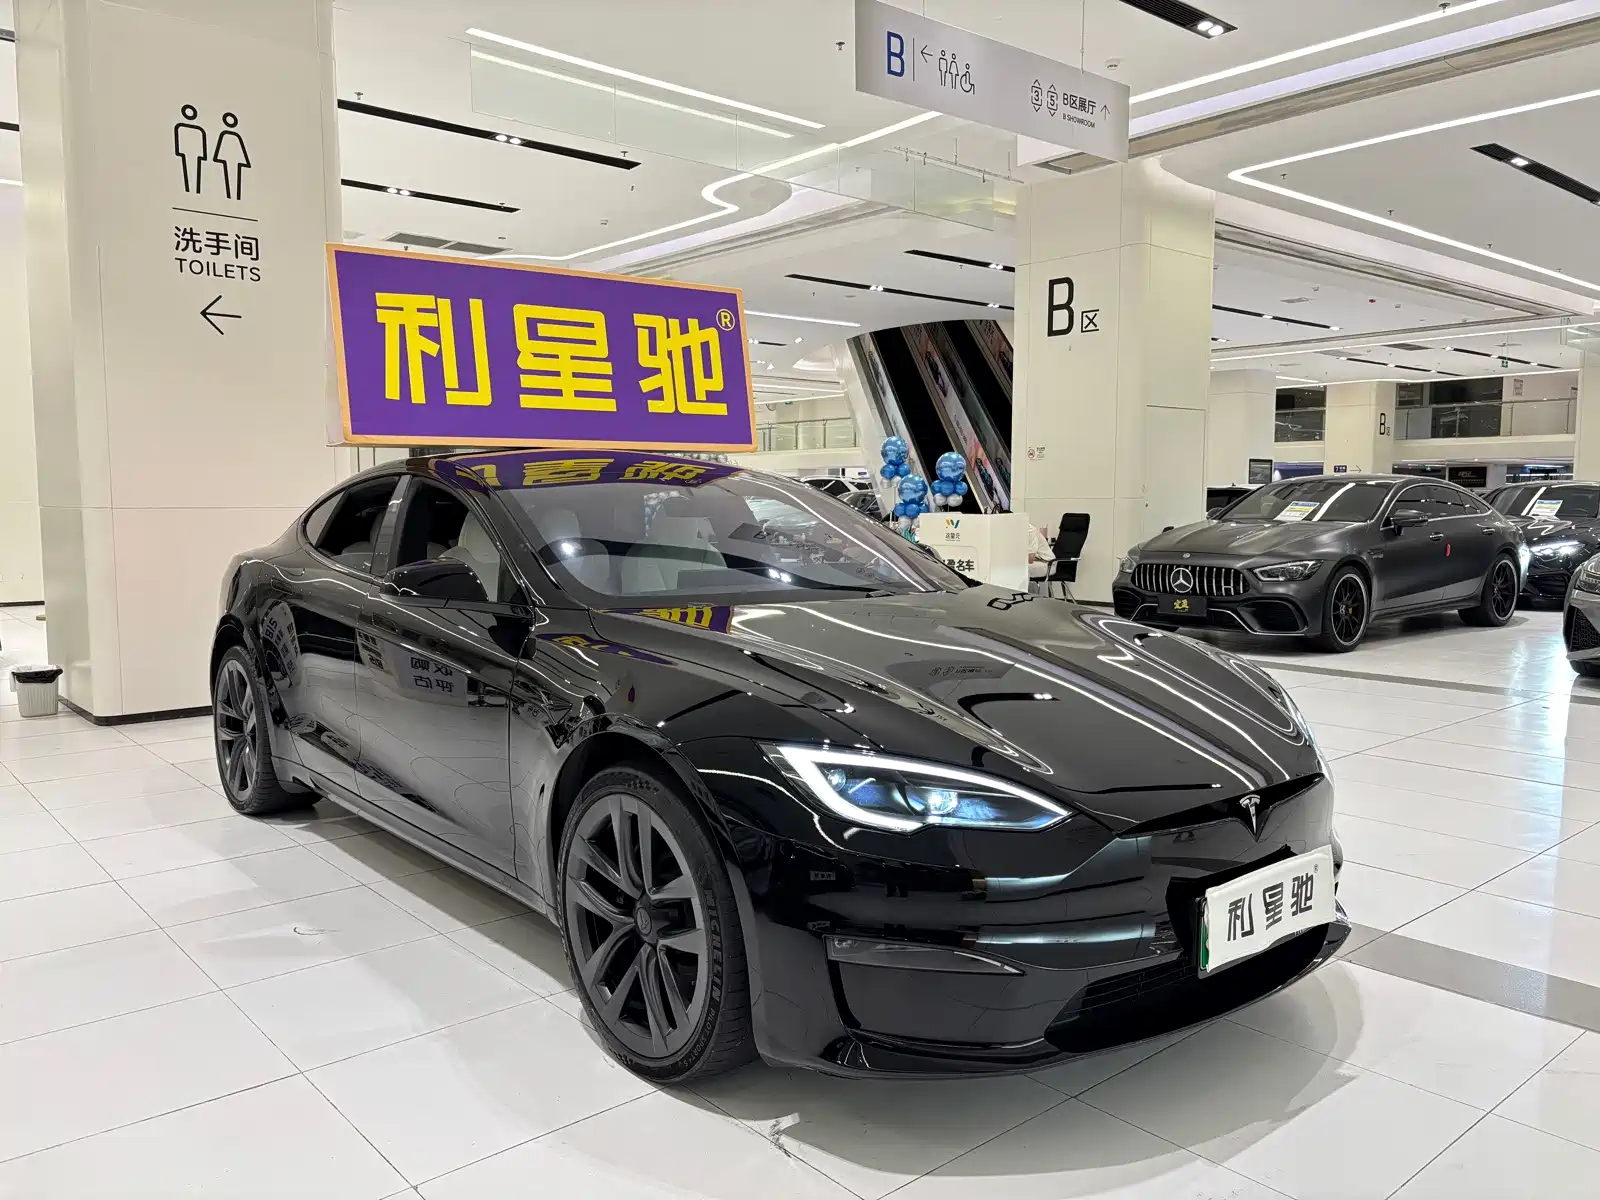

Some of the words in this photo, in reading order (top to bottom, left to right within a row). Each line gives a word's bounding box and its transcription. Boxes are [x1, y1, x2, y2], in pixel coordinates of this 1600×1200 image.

[887, 31, 905, 78] B
[1062, 93, 1097, 115] B区展厅
[1066, 114, 1096, 129] SHOWROOM
[174, 226, 260, 261] 洗手间
[174, 257, 261, 282] TOILETS
[942, 559, 975, 572] 盈名车
[703, 889, 723, 1002] MICHELIN
[705, 1008, 716, 1036] PILOT
[689, 1036, 707, 1061] SPORT
